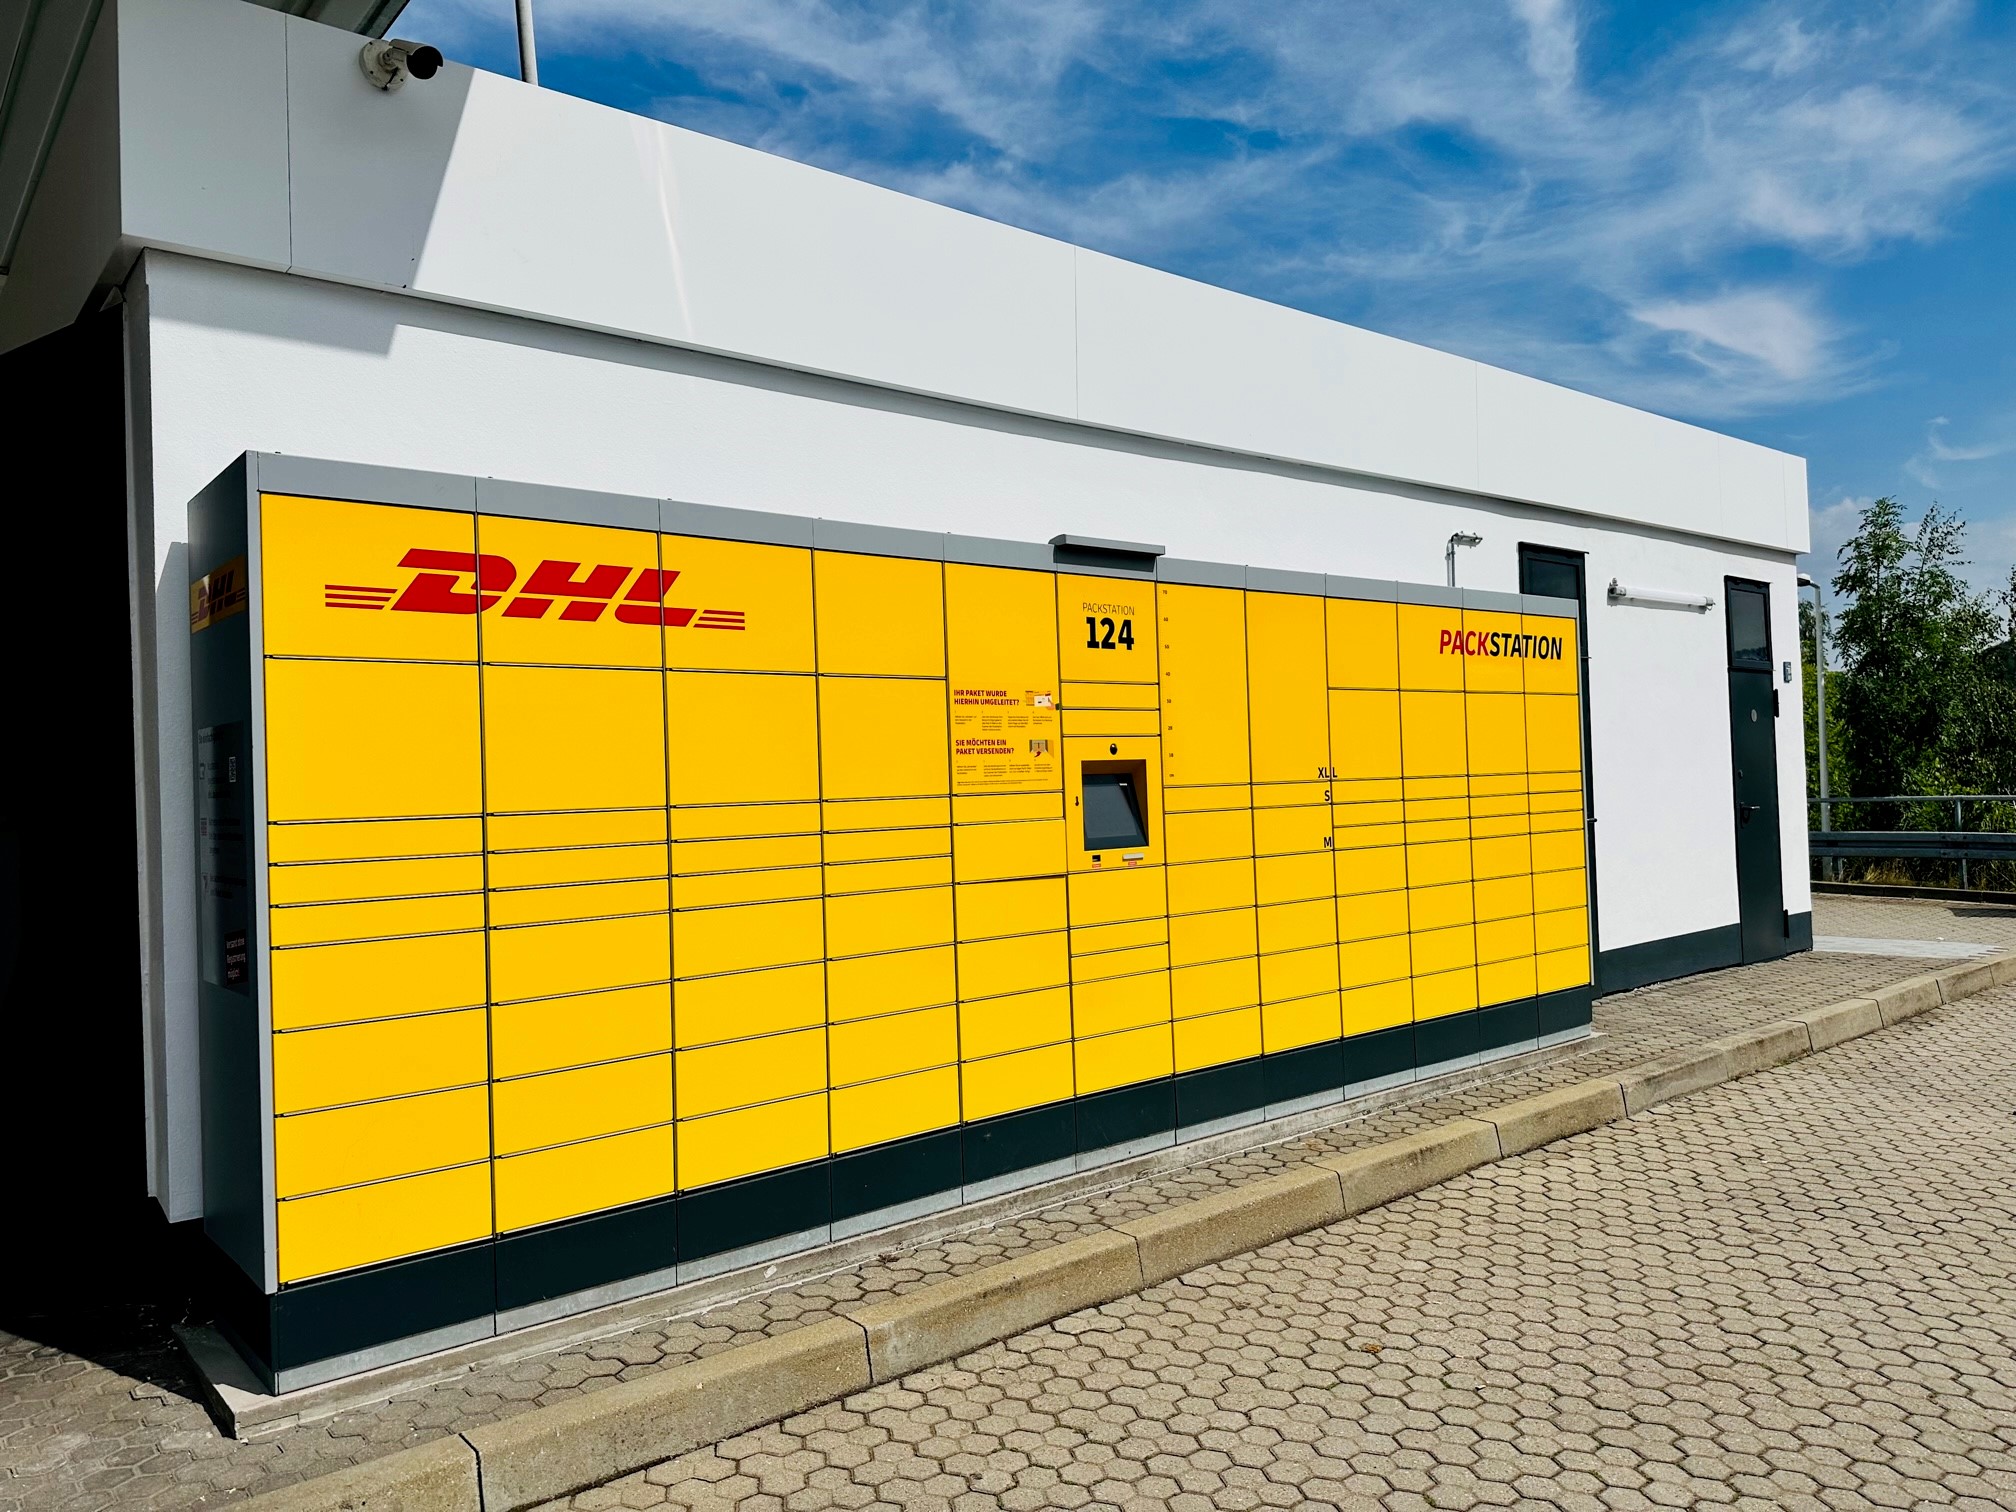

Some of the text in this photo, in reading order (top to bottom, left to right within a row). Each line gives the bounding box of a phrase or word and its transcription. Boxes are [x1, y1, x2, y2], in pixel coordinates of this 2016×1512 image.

[391, 548, 697, 628] DHL
[1082, 602, 1135, 616] PACKSTATION
[1086, 616, 1135, 651] 124
[1439, 629, 1563, 660] PACKSTATION
[966, 689, 984, 697] PAKET
[981, 698, 1020, 706] UMGELEITET?
[966, 738, 995, 746] MÖCHTEN
[976, 747, 1015, 755] VERSENDEN?
[1317, 767, 1330, 779] XL
[1332, 767, 1338, 779] L
[1324, 790, 1331, 802] S
[1323, 836, 1332, 849] M
